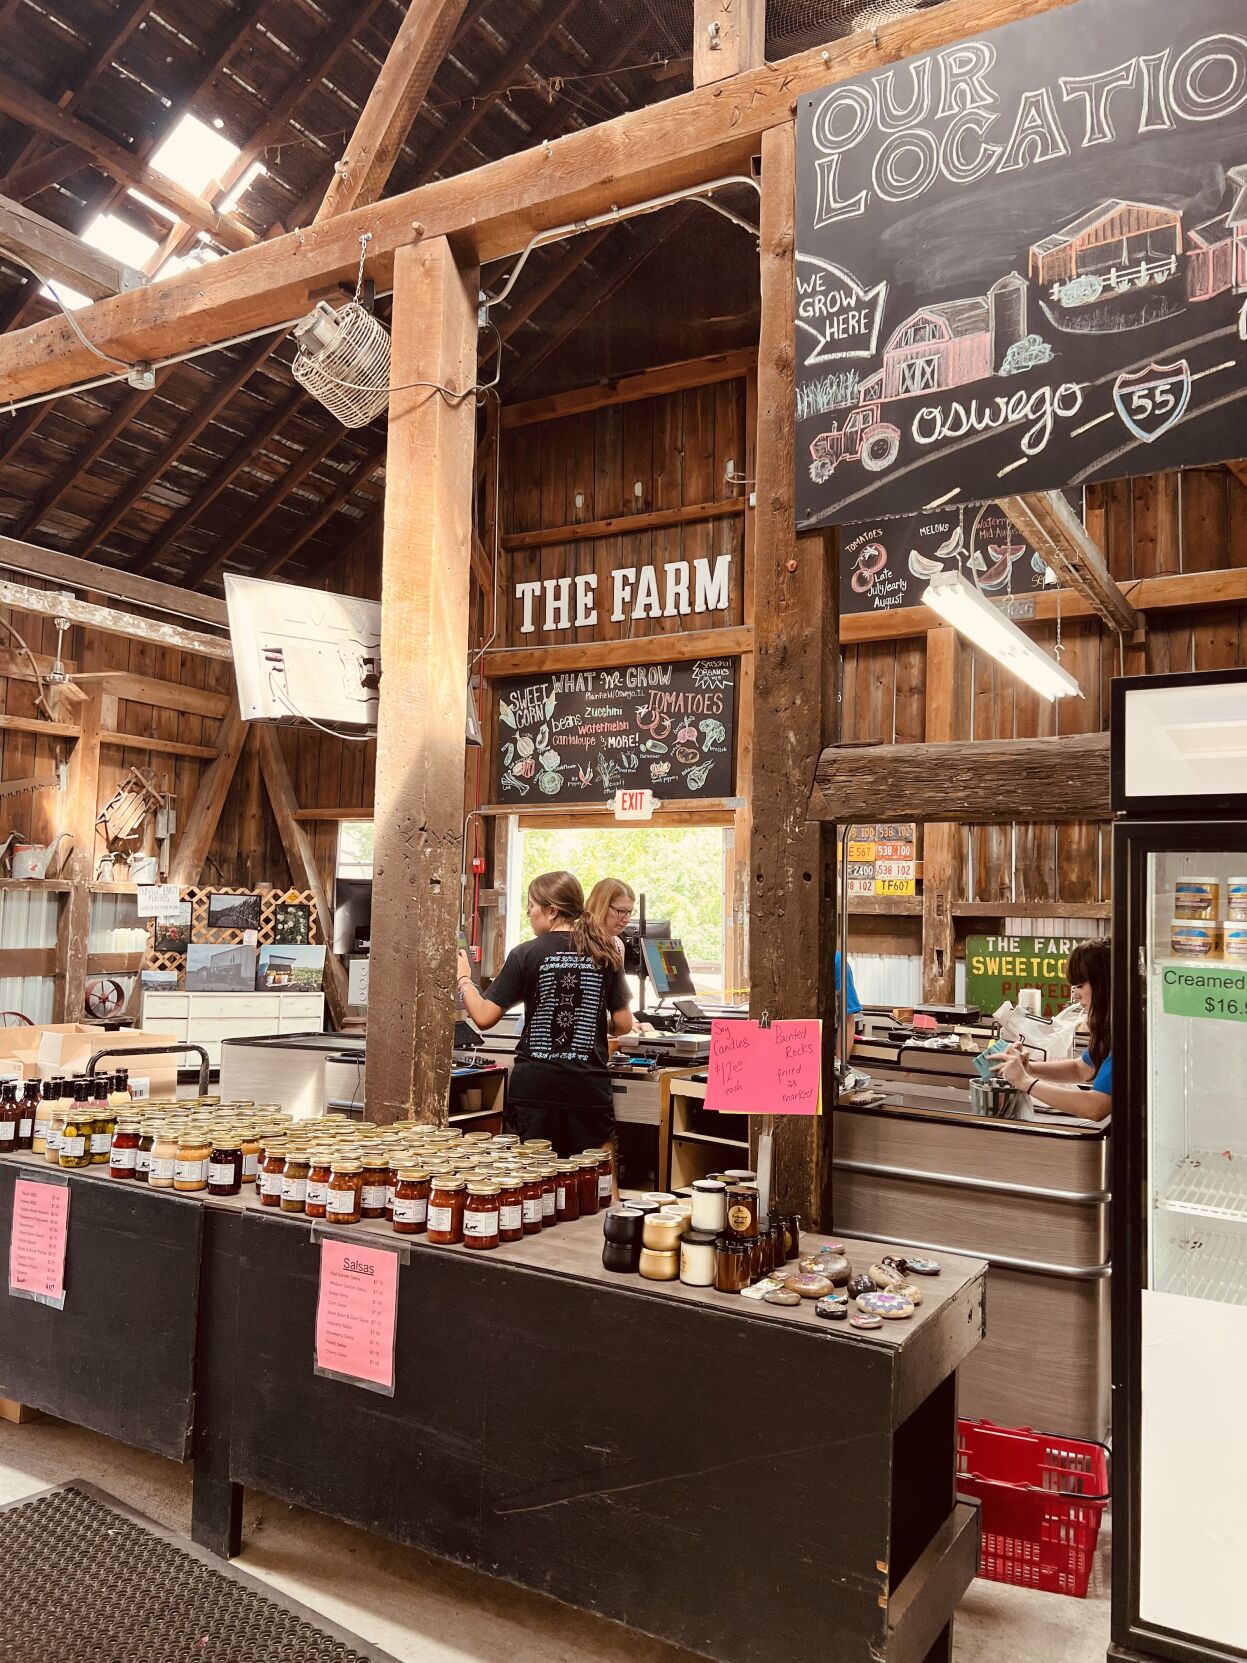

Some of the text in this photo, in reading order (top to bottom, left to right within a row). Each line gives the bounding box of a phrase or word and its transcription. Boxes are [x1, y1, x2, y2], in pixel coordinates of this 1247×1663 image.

[812, 40, 999, 153] OUR
[813, 33, 1247, 229] LOCATIO
[796, 271, 826, 295] WE
[799, 289, 857, 318] GROW
[825, 309, 869, 341] HERE
[1131, 385, 1175, 420] 55
[919, 523, 950, 537] MELONS
[844, 528, 883, 553] TOMATOES
[874, 568, 893, 582] Late
[515, 554, 732, 633] THE FARM
[867, 578, 907, 597] July/early
[873, 592, 905, 610] August
[552, 671, 596, 693] WHAT
[626, 665, 672, 688] GROW
[509, 683, 548, 712] SWEET
[648, 689, 724, 715] TOMATOES
[515, 703, 544, 729] CORN
[551, 714, 582, 733] beans
[577, 720, 629, 735] watermelon
[607, 732, 639, 749] MORE!
[621, 792, 645, 811] EXIT
[878, 845, 911, 856] 538 100
[878, 865, 911, 875] 538 102
[859, 881, 872, 891] 102
[881, 880, 909, 891] TF607
[986, 936, 1020, 952] THE
[1164, 970, 1245, 990] Creamed
[713, 1022, 731, 1040] Soy
[774, 1025, 807, 1045] Painted
[713, 1037, 751, 1057] Candles
[785, 1043, 814, 1059] Rocks
[725, 1080, 743, 1095] each
[782, 1088, 813, 1102] marked
[343, 1257, 375, 1274] Salsas
